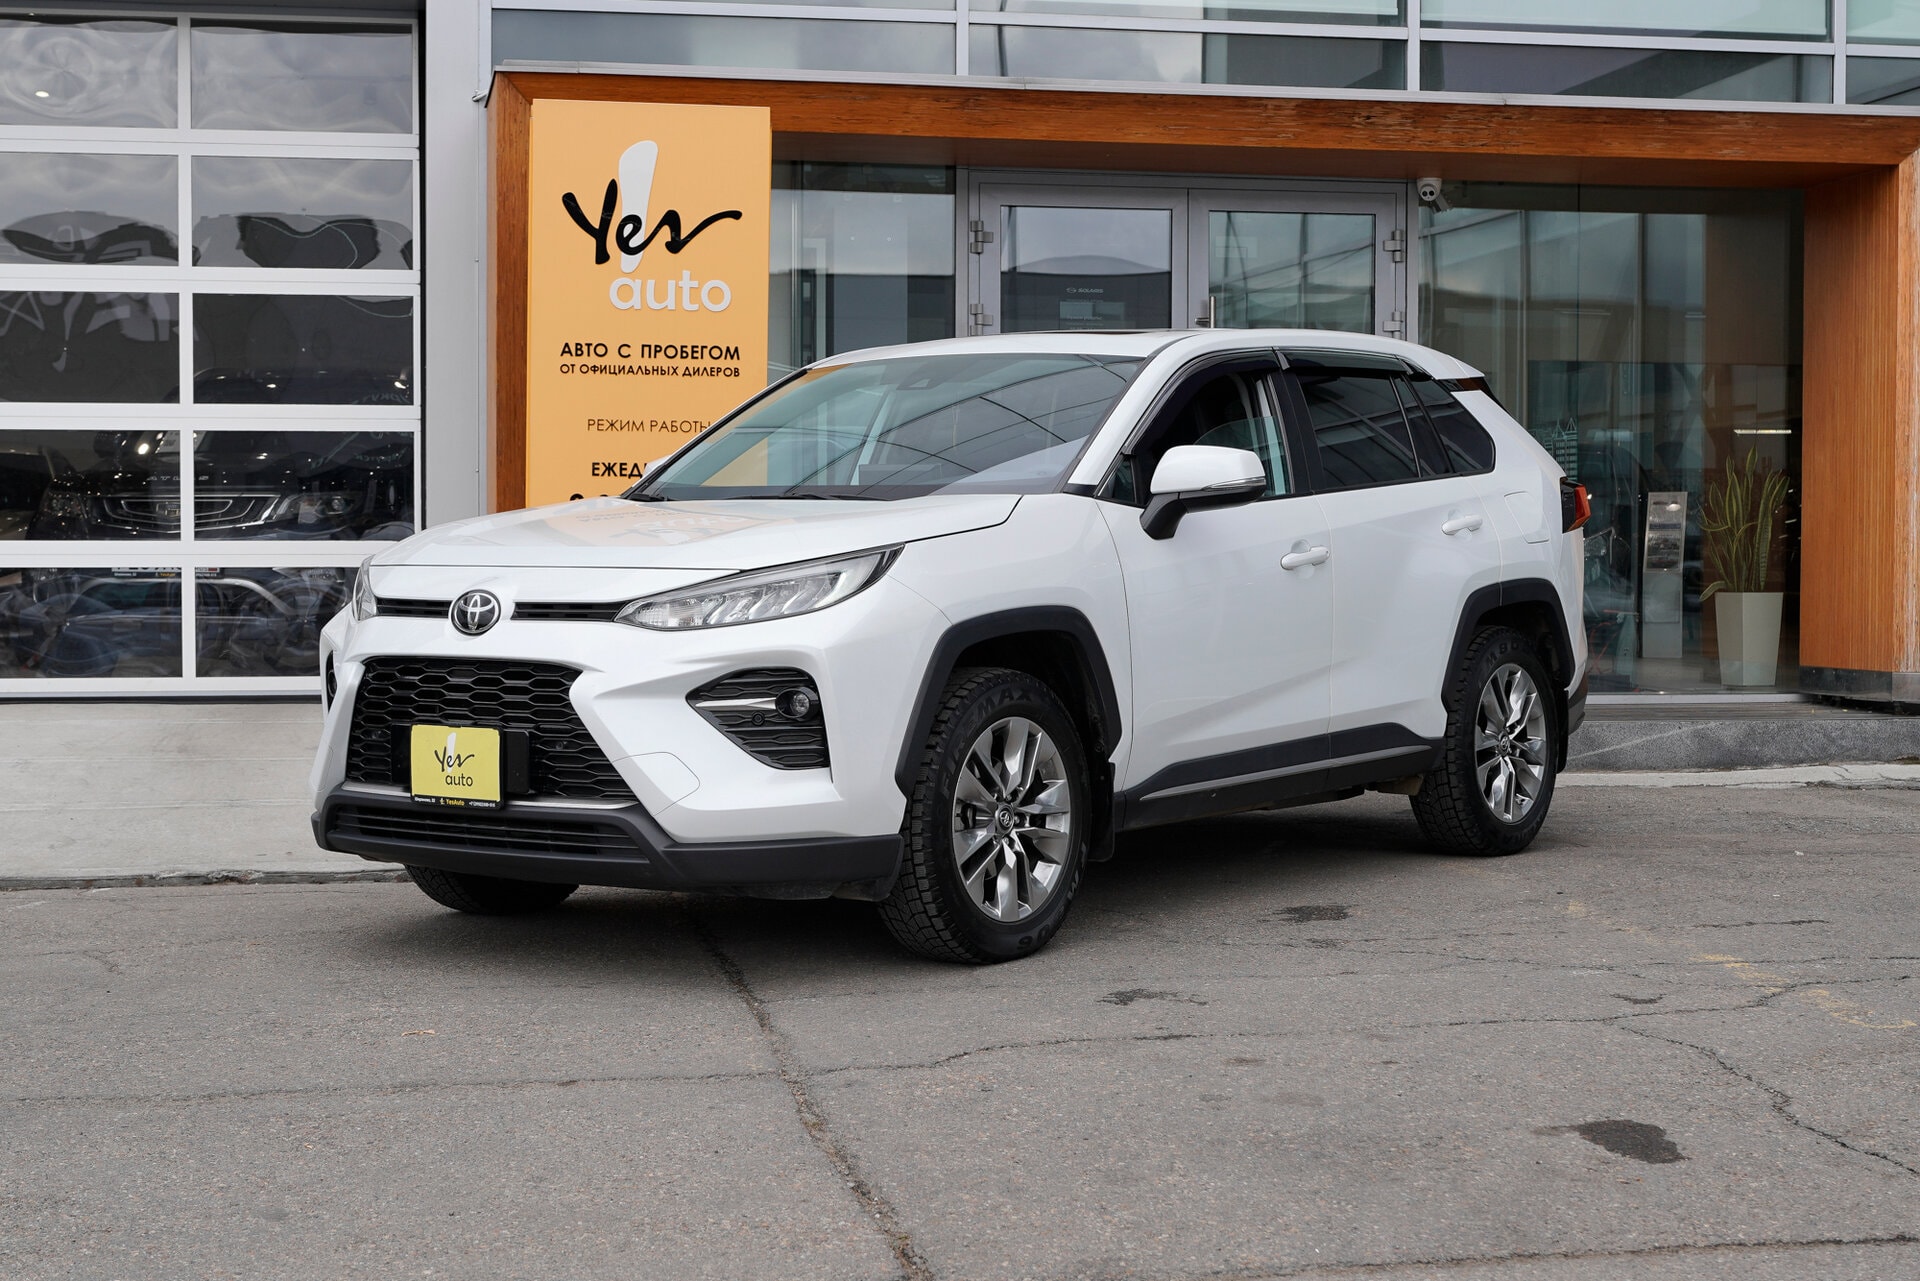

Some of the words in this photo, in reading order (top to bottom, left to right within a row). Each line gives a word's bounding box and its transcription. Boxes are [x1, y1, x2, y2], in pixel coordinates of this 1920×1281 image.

[561, 178, 743, 265] Yes
[609, 270, 732, 312] auto
[560, 342, 608, 358] АВТО
[617, 343, 631, 358] С
[640, 344, 741, 361] ПРОБЕГОМ
[559, 363, 576, 375] ОТ
[579, 364, 679, 377] ОФИЦИАЛЬНЫХ
[682, 366, 741, 378] ДИЛЕРОВ
[587, 418, 645, 432] РЕЖИМ
[591, 462, 648, 480] ЕЖЕД
[434, 746, 475, 772] Yes
[445, 773, 474, 787] auto
